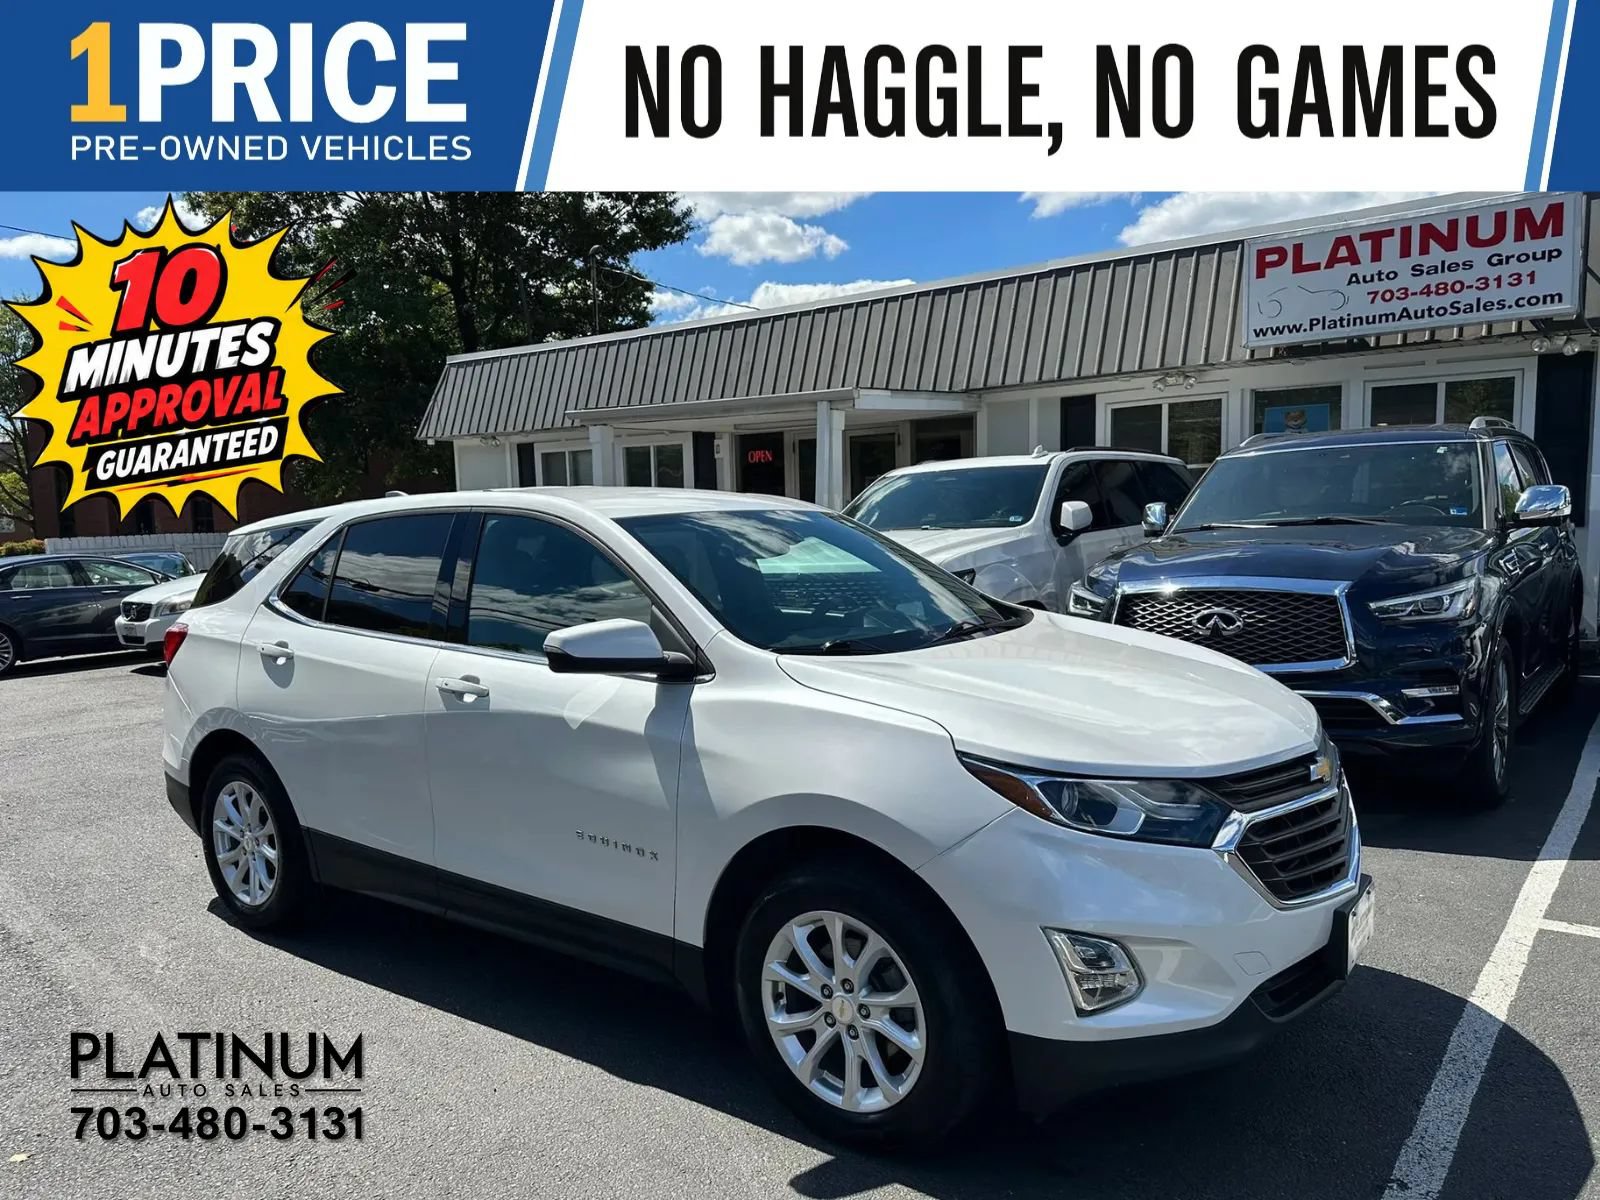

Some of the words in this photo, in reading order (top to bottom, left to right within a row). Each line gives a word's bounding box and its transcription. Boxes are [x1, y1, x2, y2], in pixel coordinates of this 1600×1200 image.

[1255, 201, 1565, 279] PLATINUM
[1346, 269, 1399, 286] Auto
[1410, 258, 1474, 278] Sales
[1486, 247, 1563, 268] Group
[1367, 270, 1537, 305] 703-480-3131
[1252, 291, 1564, 339] www.PlatinumAutoSales.com
[748, 450, 774, 464] OPEN
[575, 829, 660, 862] EQUINOX
